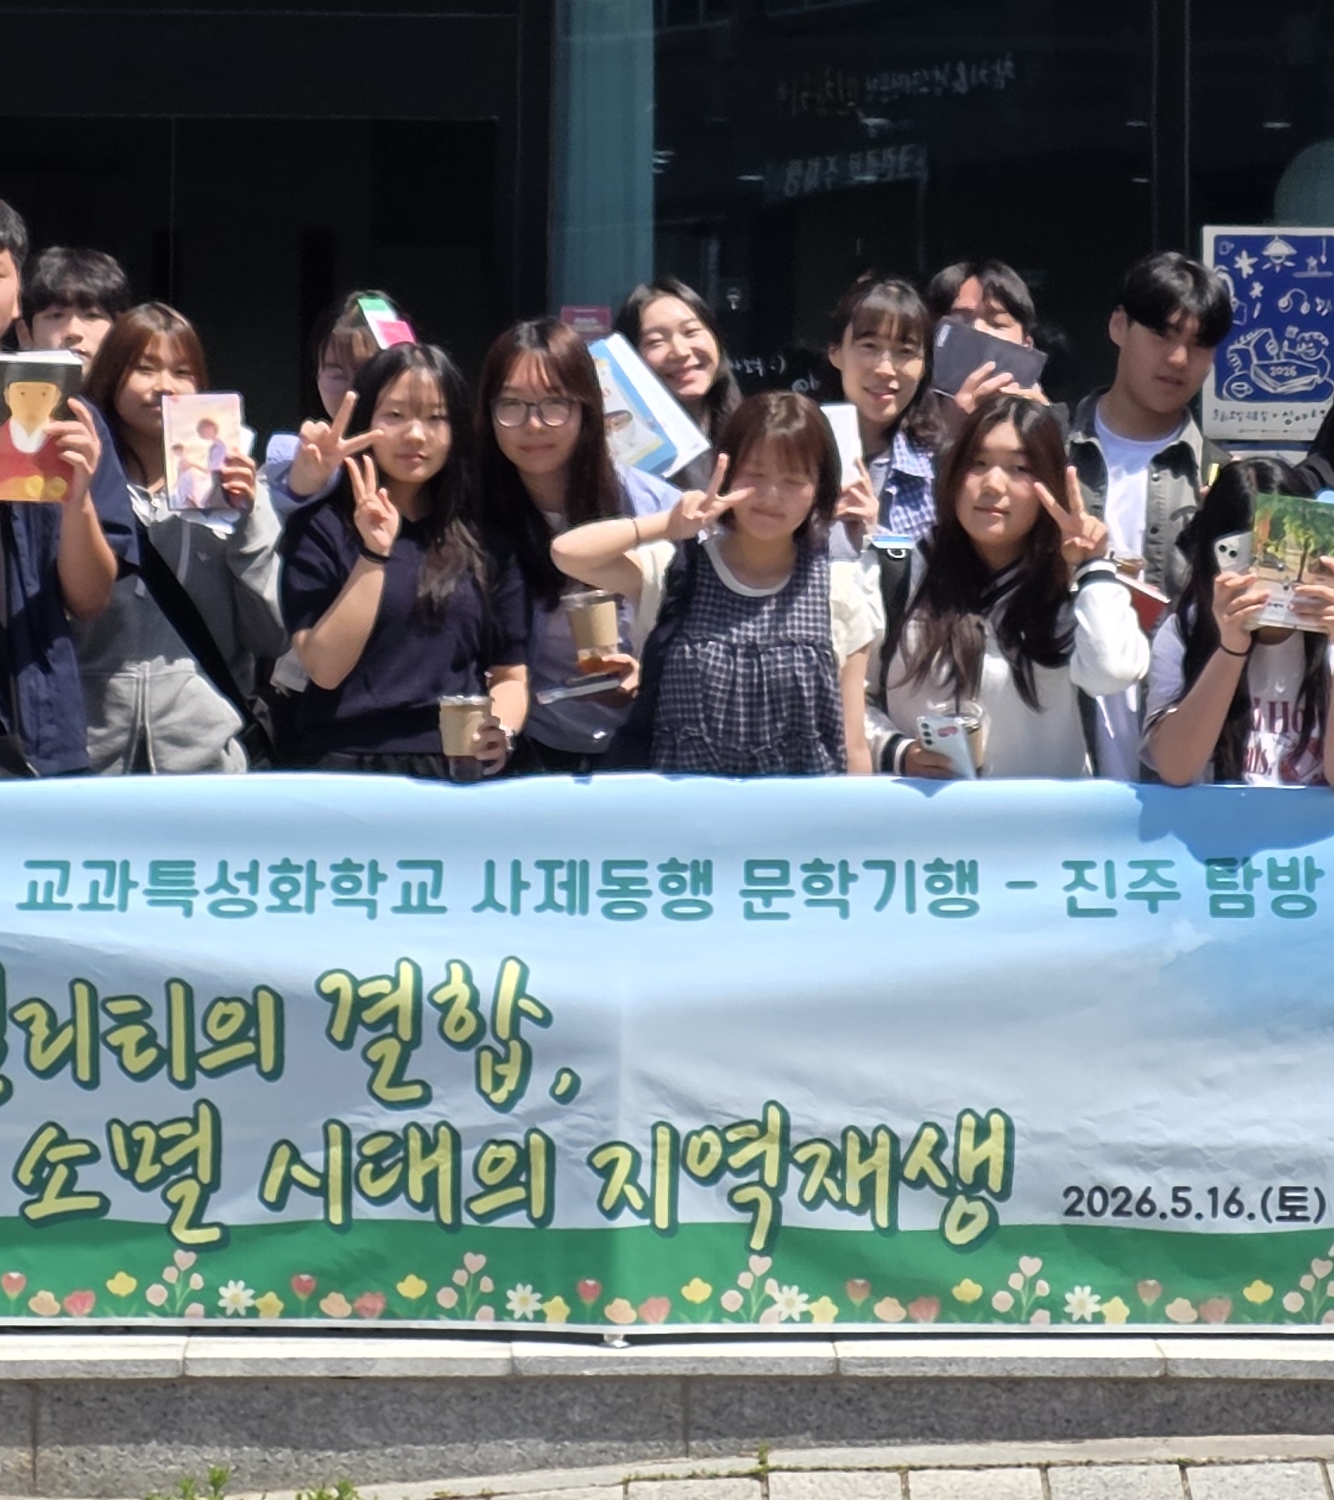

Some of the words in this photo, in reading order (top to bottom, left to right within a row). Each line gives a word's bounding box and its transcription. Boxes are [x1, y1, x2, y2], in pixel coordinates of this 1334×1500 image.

[1269, 366, 1298, 377] 2026
[15, 855, 448, 919] 교과특성화학교
[472, 856, 714, 921] 사제동행
[739, 856, 980, 920] 문학기행
[1062, 857, 1182, 919] 진주
[1206, 855, 1326, 920] 탐방
[316, 955, 583, 1110] 결합,
[14, 1098, 225, 1252] 소멸
[258, 1117, 556, 1232] 시대의
[590, 1100, 1016, 1252] 지역재생
[1062, 1185, 1327, 1224] 2026.5.16.(토)
